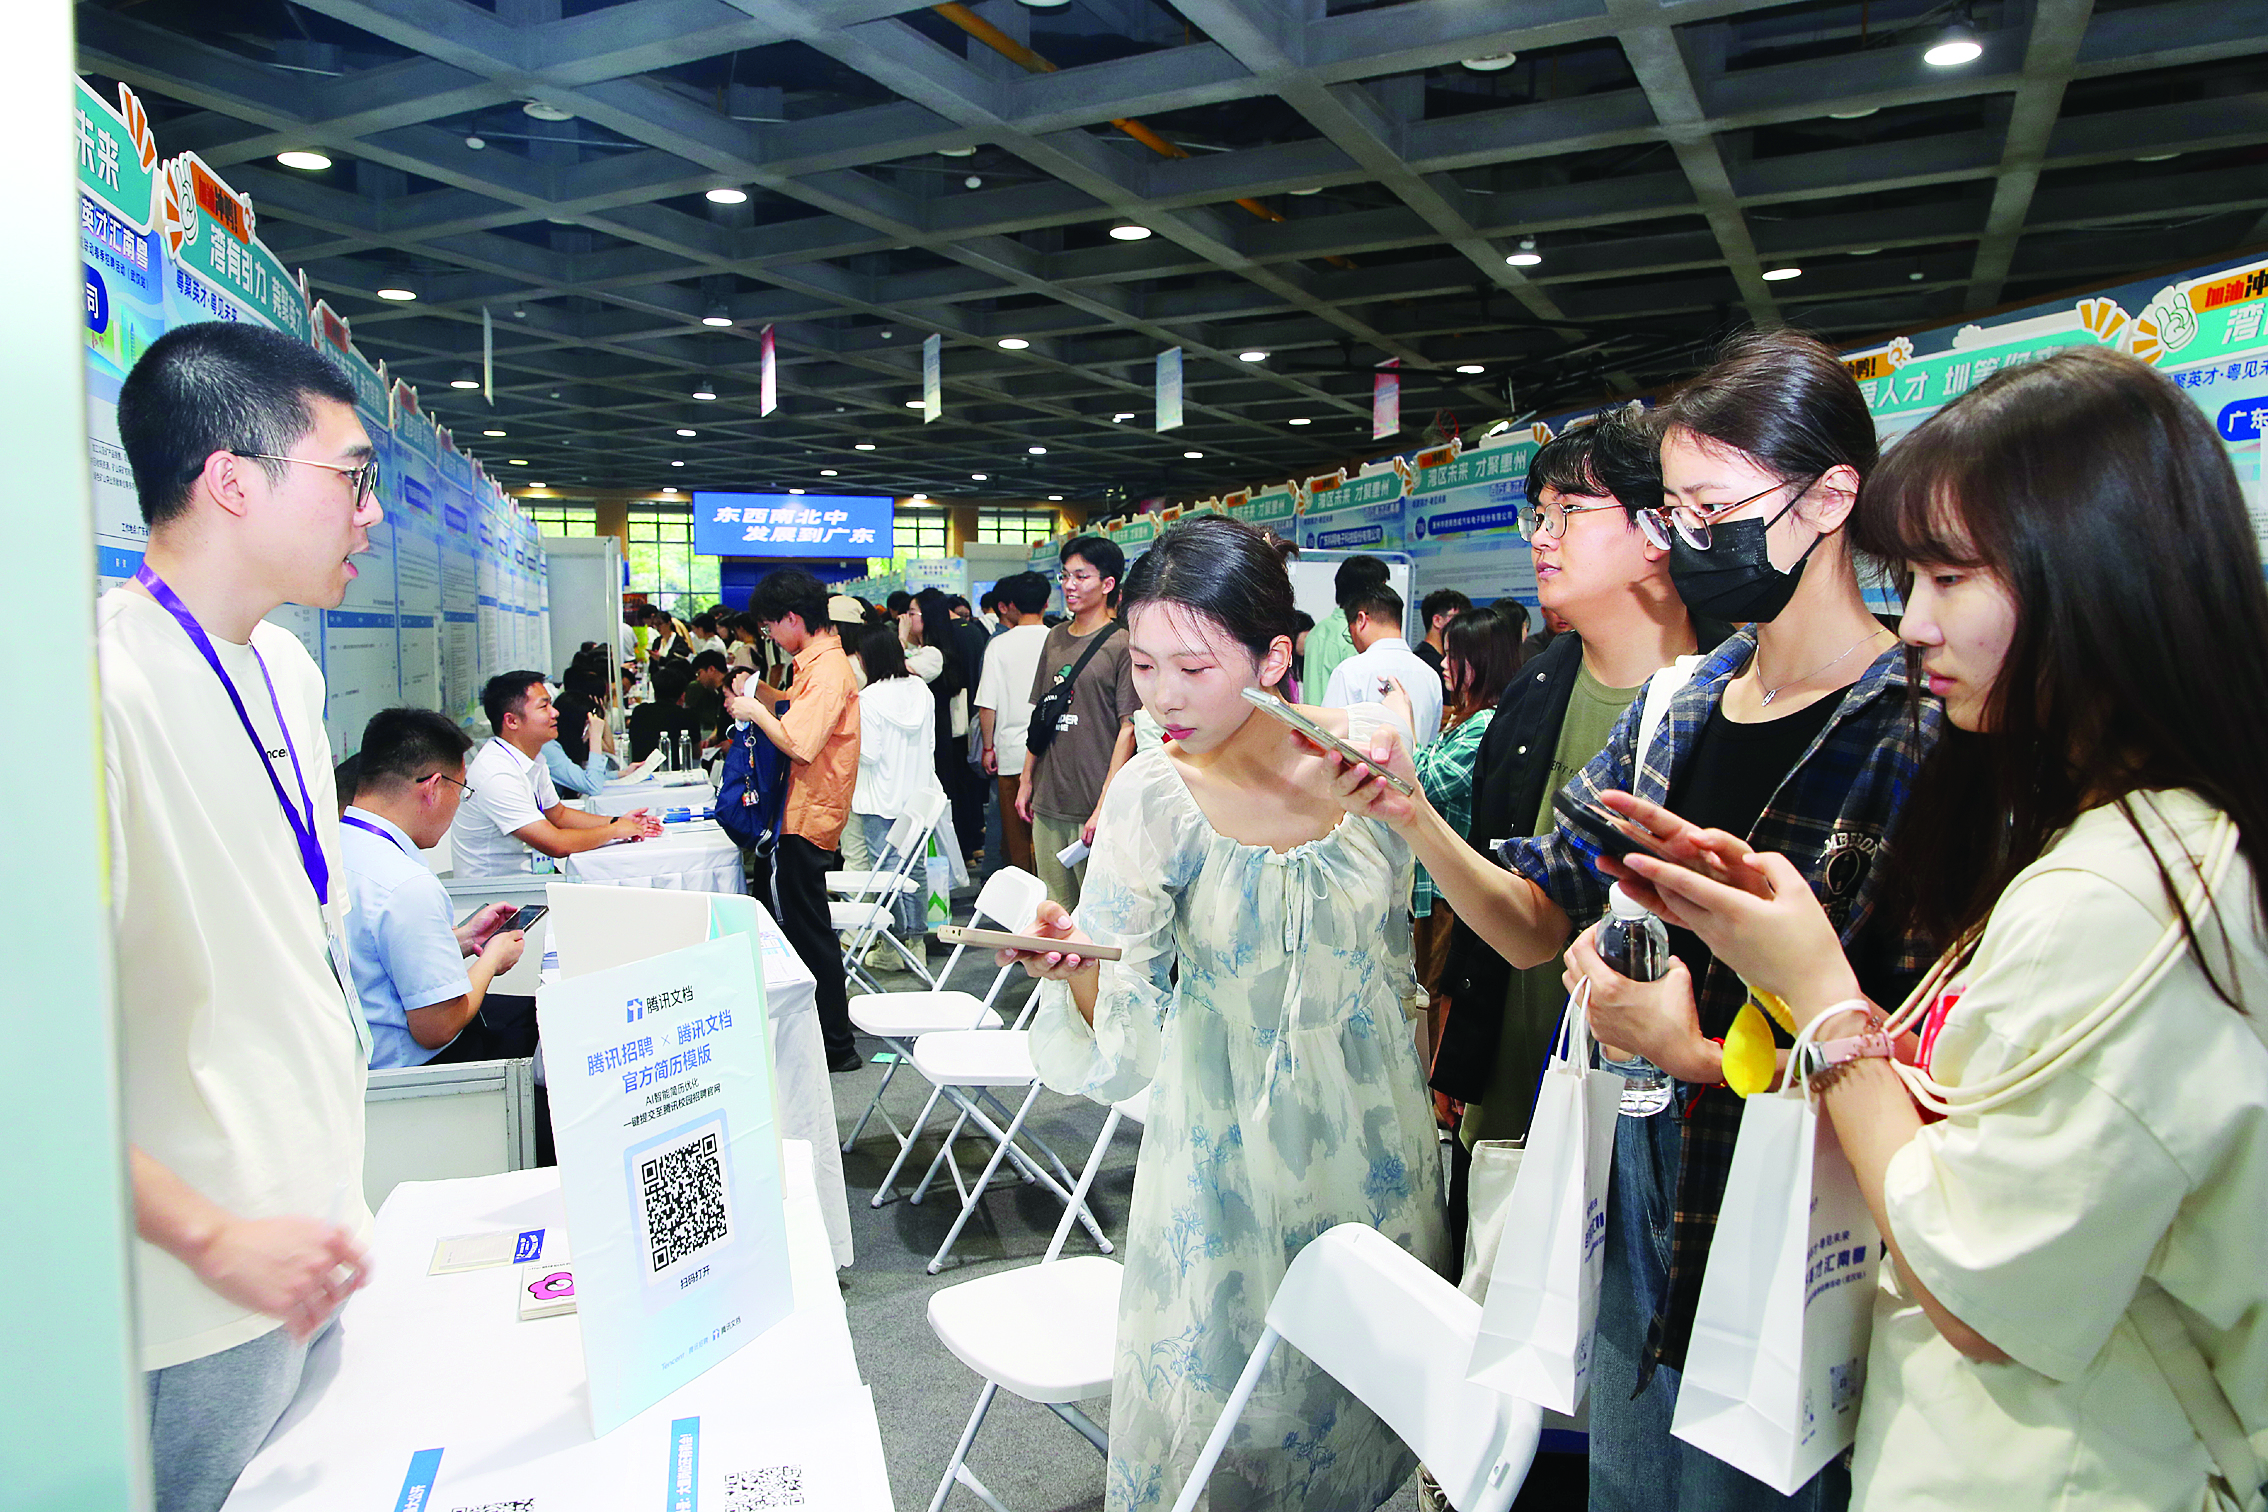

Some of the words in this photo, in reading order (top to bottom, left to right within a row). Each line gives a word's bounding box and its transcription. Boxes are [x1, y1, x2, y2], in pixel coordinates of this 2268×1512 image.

[210, 223, 268, 306] 湾有引力
[2221, 303, 2268, 345] 湾
[1474, 449, 1528, 478] 才聚惠州
[712, 506, 848, 526] 东西南北中
[742, 525, 876, 543] 发展到广东
[266, 748, 289, 759] nce
[646, 984, 695, 1015] 腾讯文档
[587, 1035, 655, 1077] 腾讯招聘
[676, 1008, 734, 1046] 腾讯文档
[621, 1042, 713, 1095] 官方简历模版
[623, 1082, 722, 1128] 一键提交至腾讯校园招聘官网
[644, 1076, 700, 1107] AI智能简历优化
[680, 1264, 711, 1290] 扫码打开
